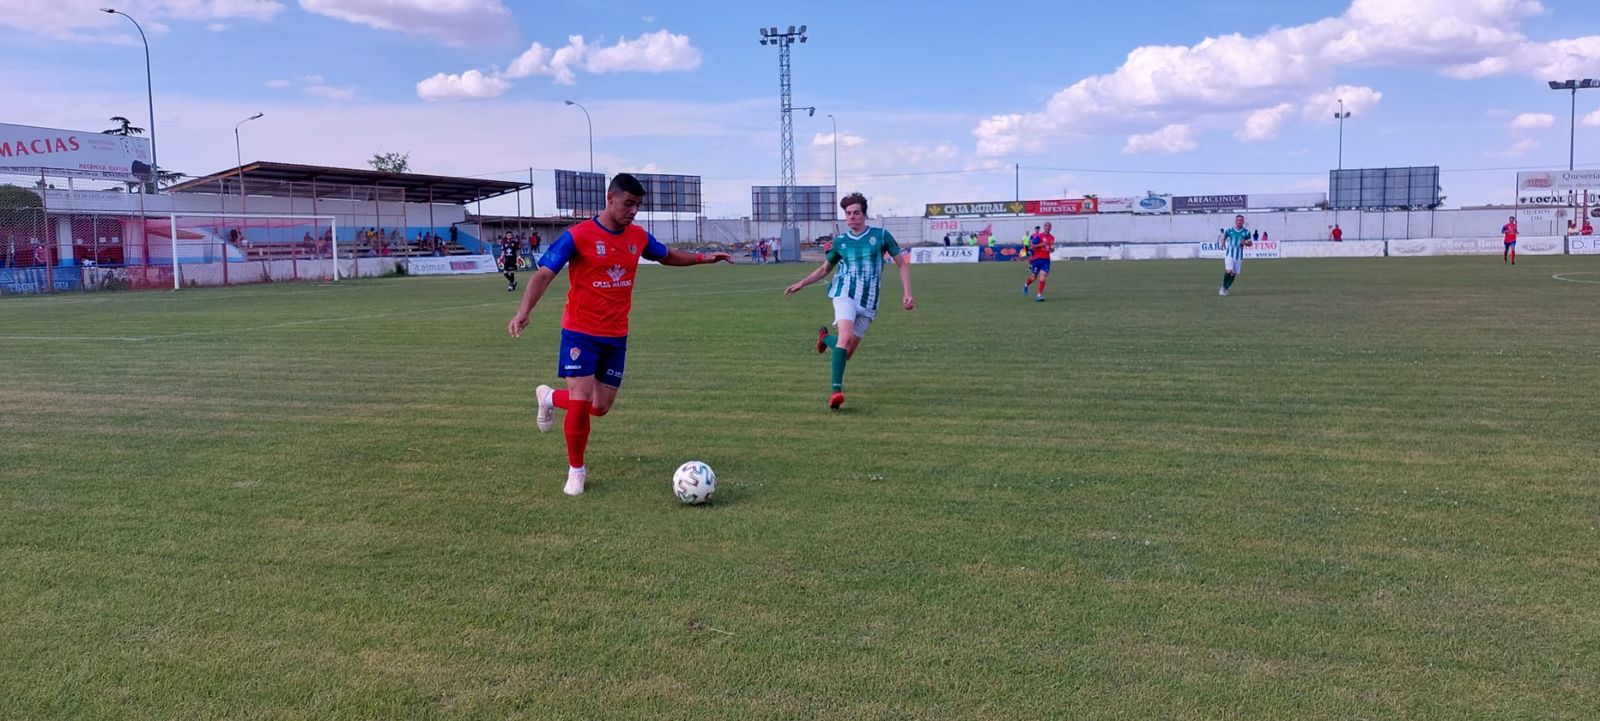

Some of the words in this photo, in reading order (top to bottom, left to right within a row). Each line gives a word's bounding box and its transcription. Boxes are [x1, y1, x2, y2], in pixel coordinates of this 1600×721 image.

[0, 136, 80, 157] MACIAS
[1529, 196, 1565, 204] LOCAL
[944, 205, 969, 214] CAJA
[971, 203, 1007, 213] RURAL
